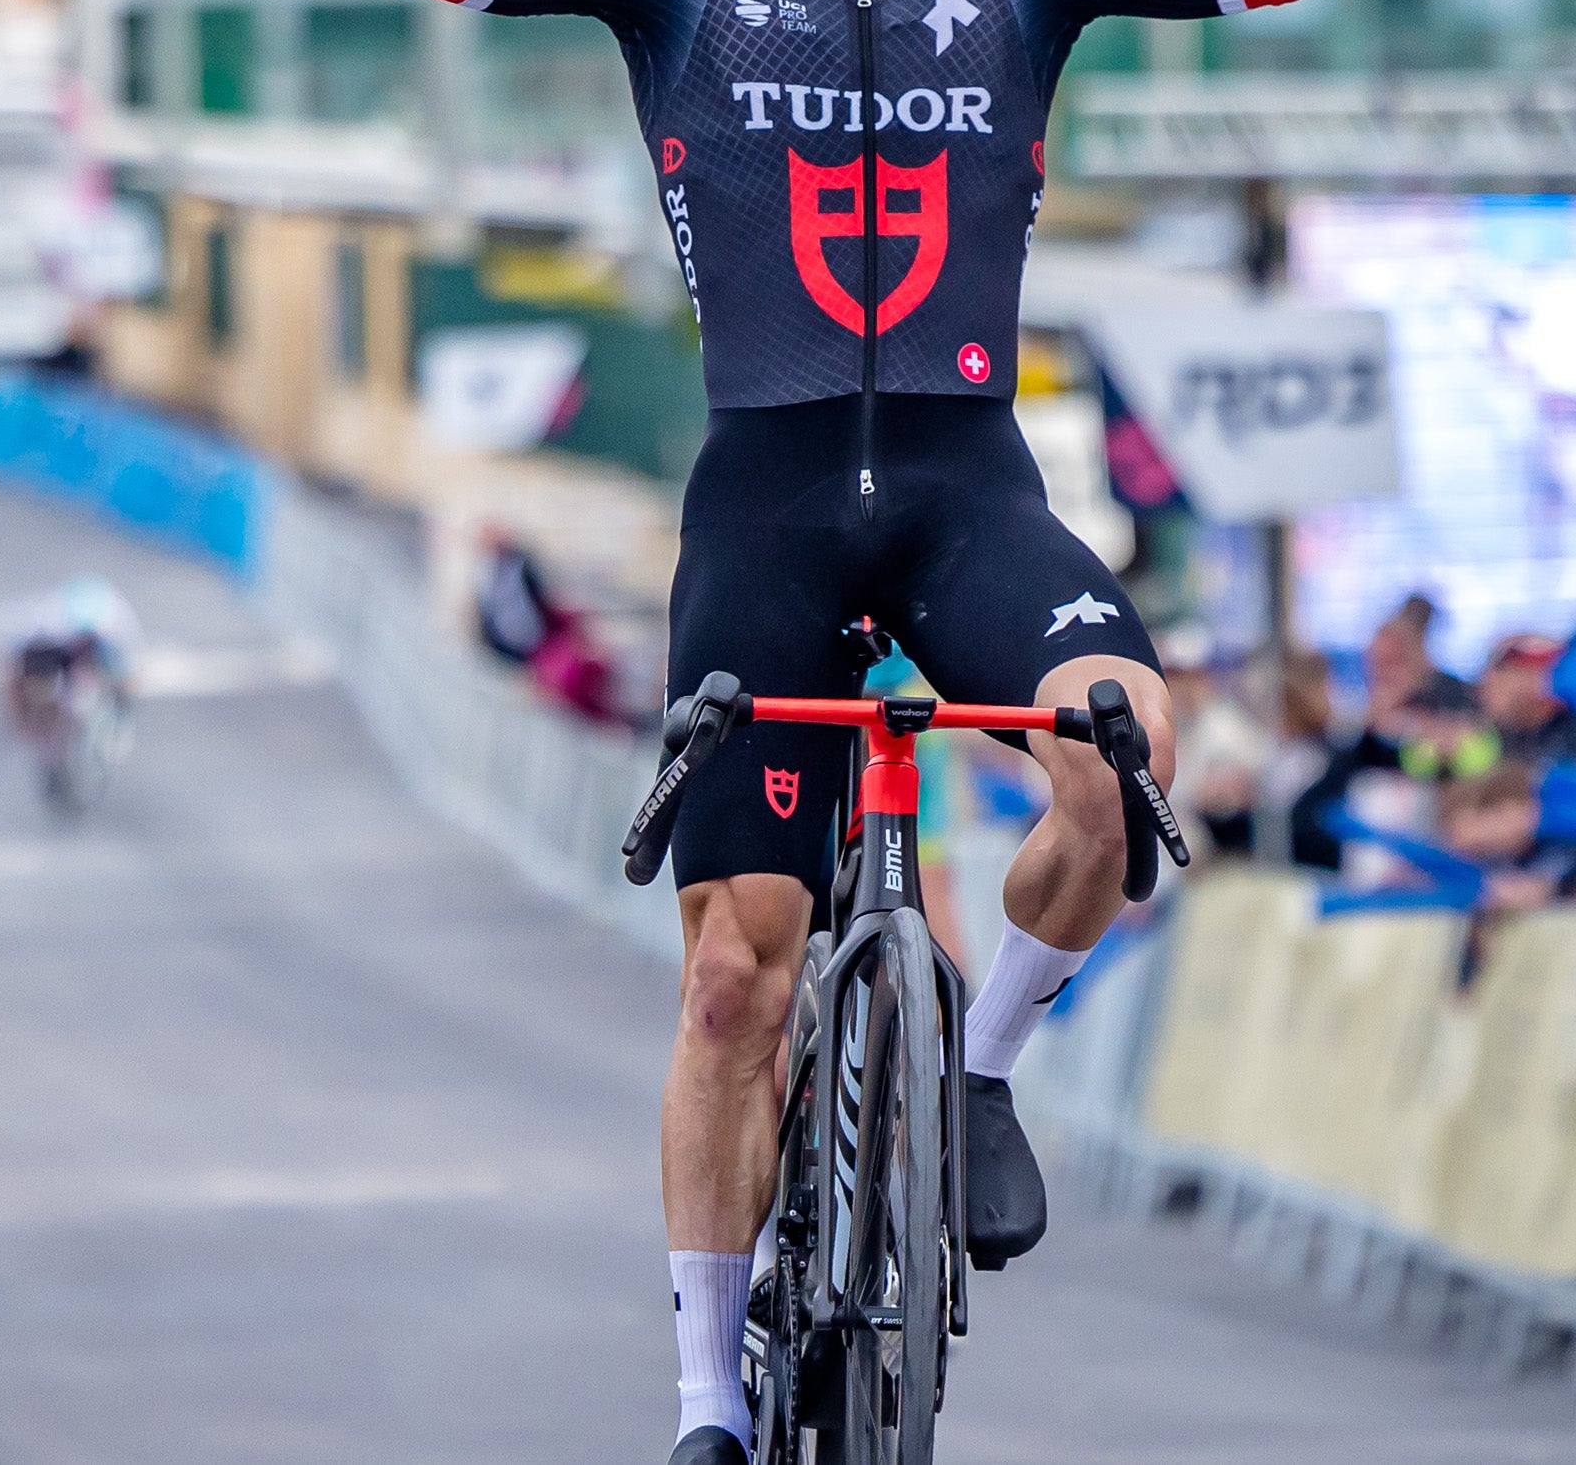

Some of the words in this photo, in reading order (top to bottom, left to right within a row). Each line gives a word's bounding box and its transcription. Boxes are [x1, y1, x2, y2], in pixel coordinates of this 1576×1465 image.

[778, 8, 807, 21] PRO
[781, 19, 817, 34] TEAM
[732, 81, 993, 134] TUDOR
[891, 708, 930, 717] wahoo
[634, 759, 689, 833] SRAM
[1133, 768, 1180, 839] SRAM
[885, 828, 903, 892] BMC
